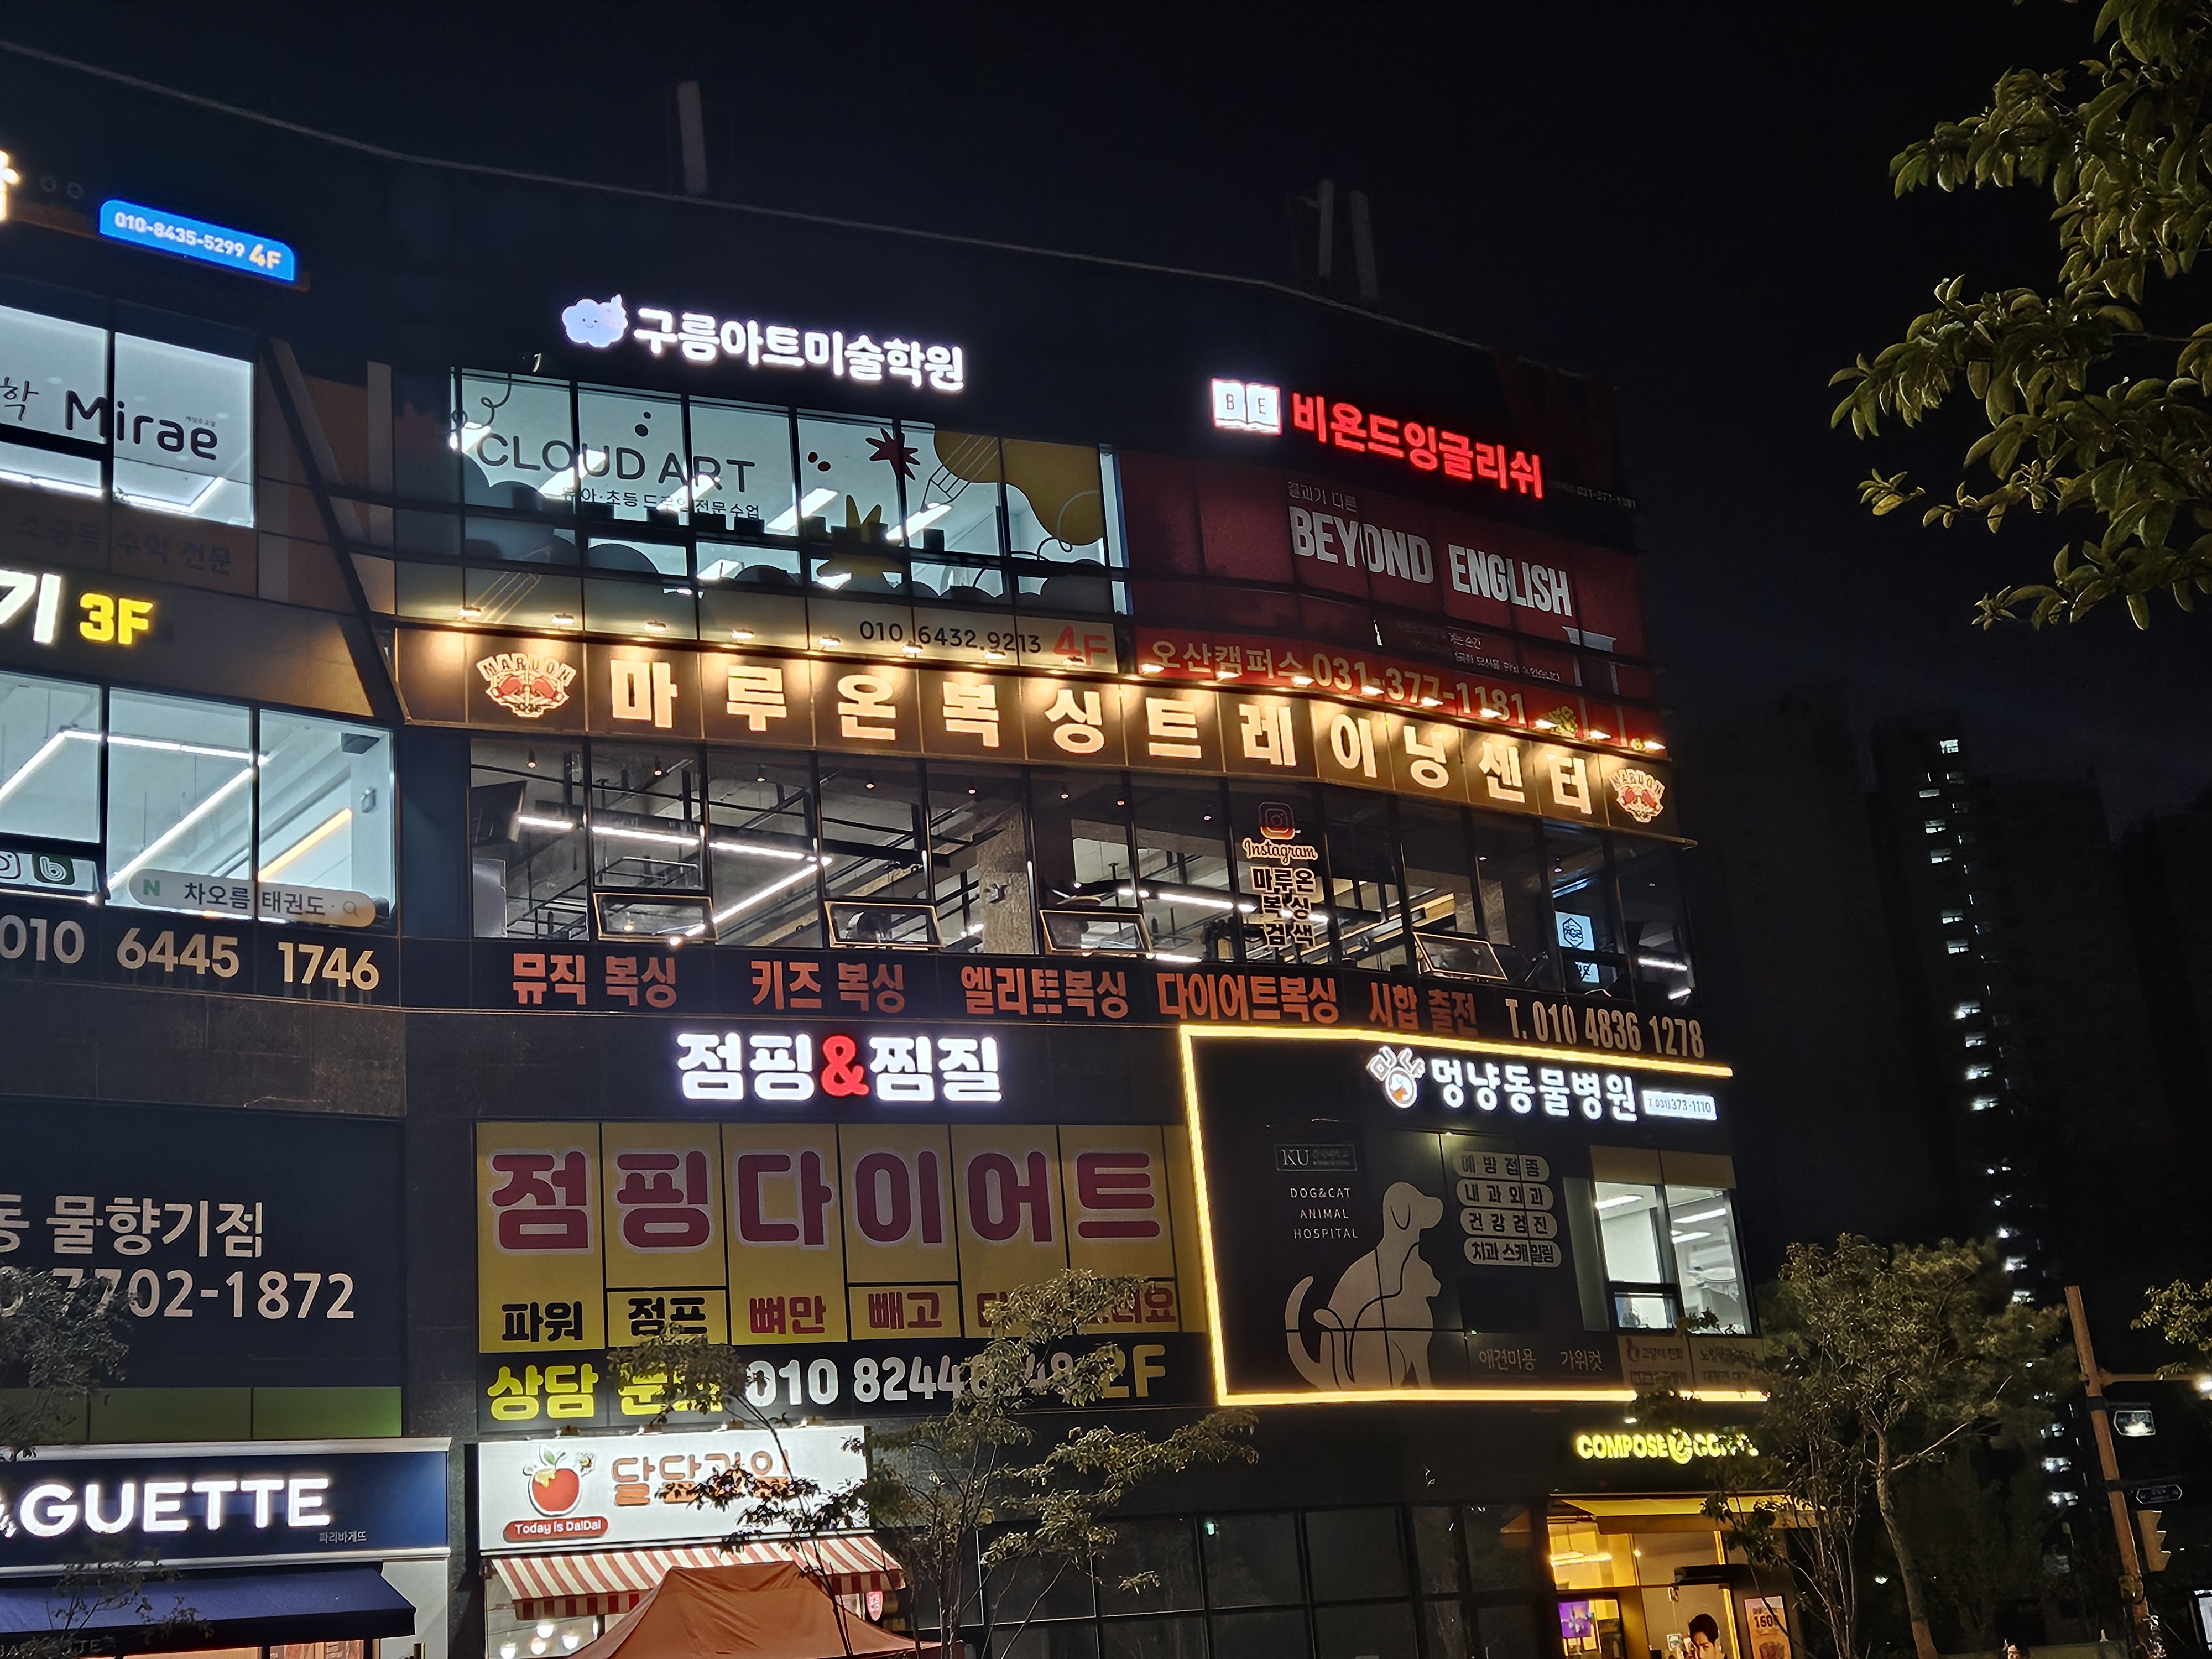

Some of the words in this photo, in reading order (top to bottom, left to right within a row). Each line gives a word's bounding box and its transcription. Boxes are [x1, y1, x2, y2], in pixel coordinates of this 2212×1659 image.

[114, 212, 245, 257] 010-8435-5299
[248, 243, 281, 269] 4F
[633, 307, 965, 391] 구름아트미술학원
[65, 390, 217, 460] Mirae
[1292, 392, 1544, 499] 비욘드잉글리쉬
[477, 432, 645, 480] CLOUD
[658, 452, 755, 493] ART
[1288, 505, 1434, 584] BEYOND
[1448, 543, 1573, 617] ENGLISH
[80, 593, 154, 645] 3F
[1053, 624, 1108, 666] 4F
[1152, 640, 1305, 679] 오산캠퍼스
[1243, 838, 1317, 864] Instagram
[184, 881, 250, 910] 차오름
[262, 891, 326, 915] 태권도
[1251, 868, 1315, 893] 마루온
[1263, 895, 1310, 920] 복싱
[0, 915, 85, 964] 010
[116, 928, 239, 978] 6445
[278, 942, 380, 990] 1746
[1266, 924, 1314, 947] 검색
[513, 953, 586, 1005] 뮤직
[605, 956, 677, 1008] 복싱
[750, 961, 822, 1010] 키즈
[838, 963, 905, 1014] 복싱
[961, 966, 1129, 1019] 엘리트복싱
[1157, 972, 1340, 1024] 다이어트복싱
[1369, 981, 1420, 1031] 시합
[1428, 988, 1479, 1037] 출전
[1585, 1008, 1642, 1052] 4836
[1648, 1015, 1705, 1058] 1278
[676, 1031, 1003, 1102] 점핑&찜질
[1430, 1058, 1638, 1122] 멍냥동물병원
[1281, 1149, 1309, 1166] KU
[1290, 1187, 1350, 1199] DOG&CAT
[1300, 1208, 1349, 1219] ANIMAL
[46, 1194, 263, 1258] 물향기점
[1293, 1228, 1358, 1239] HOSPITAL
[501, 1300, 583, 1342] 파워
[628, 1296, 708, 1336] 점프
[749, 1295, 827, 1335] 뼈만
[868, 1292, 942, 1330] 빼고
[487, 1363, 599, 1421] 상담
[745, 1358, 839, 1407] 010
[1577, 1433, 1670, 1459] COMPOSE
[0, 1478, 331, 1538] GUETTE
[514, 1522, 551, 1535] Today
[554, 1521, 564, 1533] is
[319, 1530, 367, 1543] 파리바게뜨
